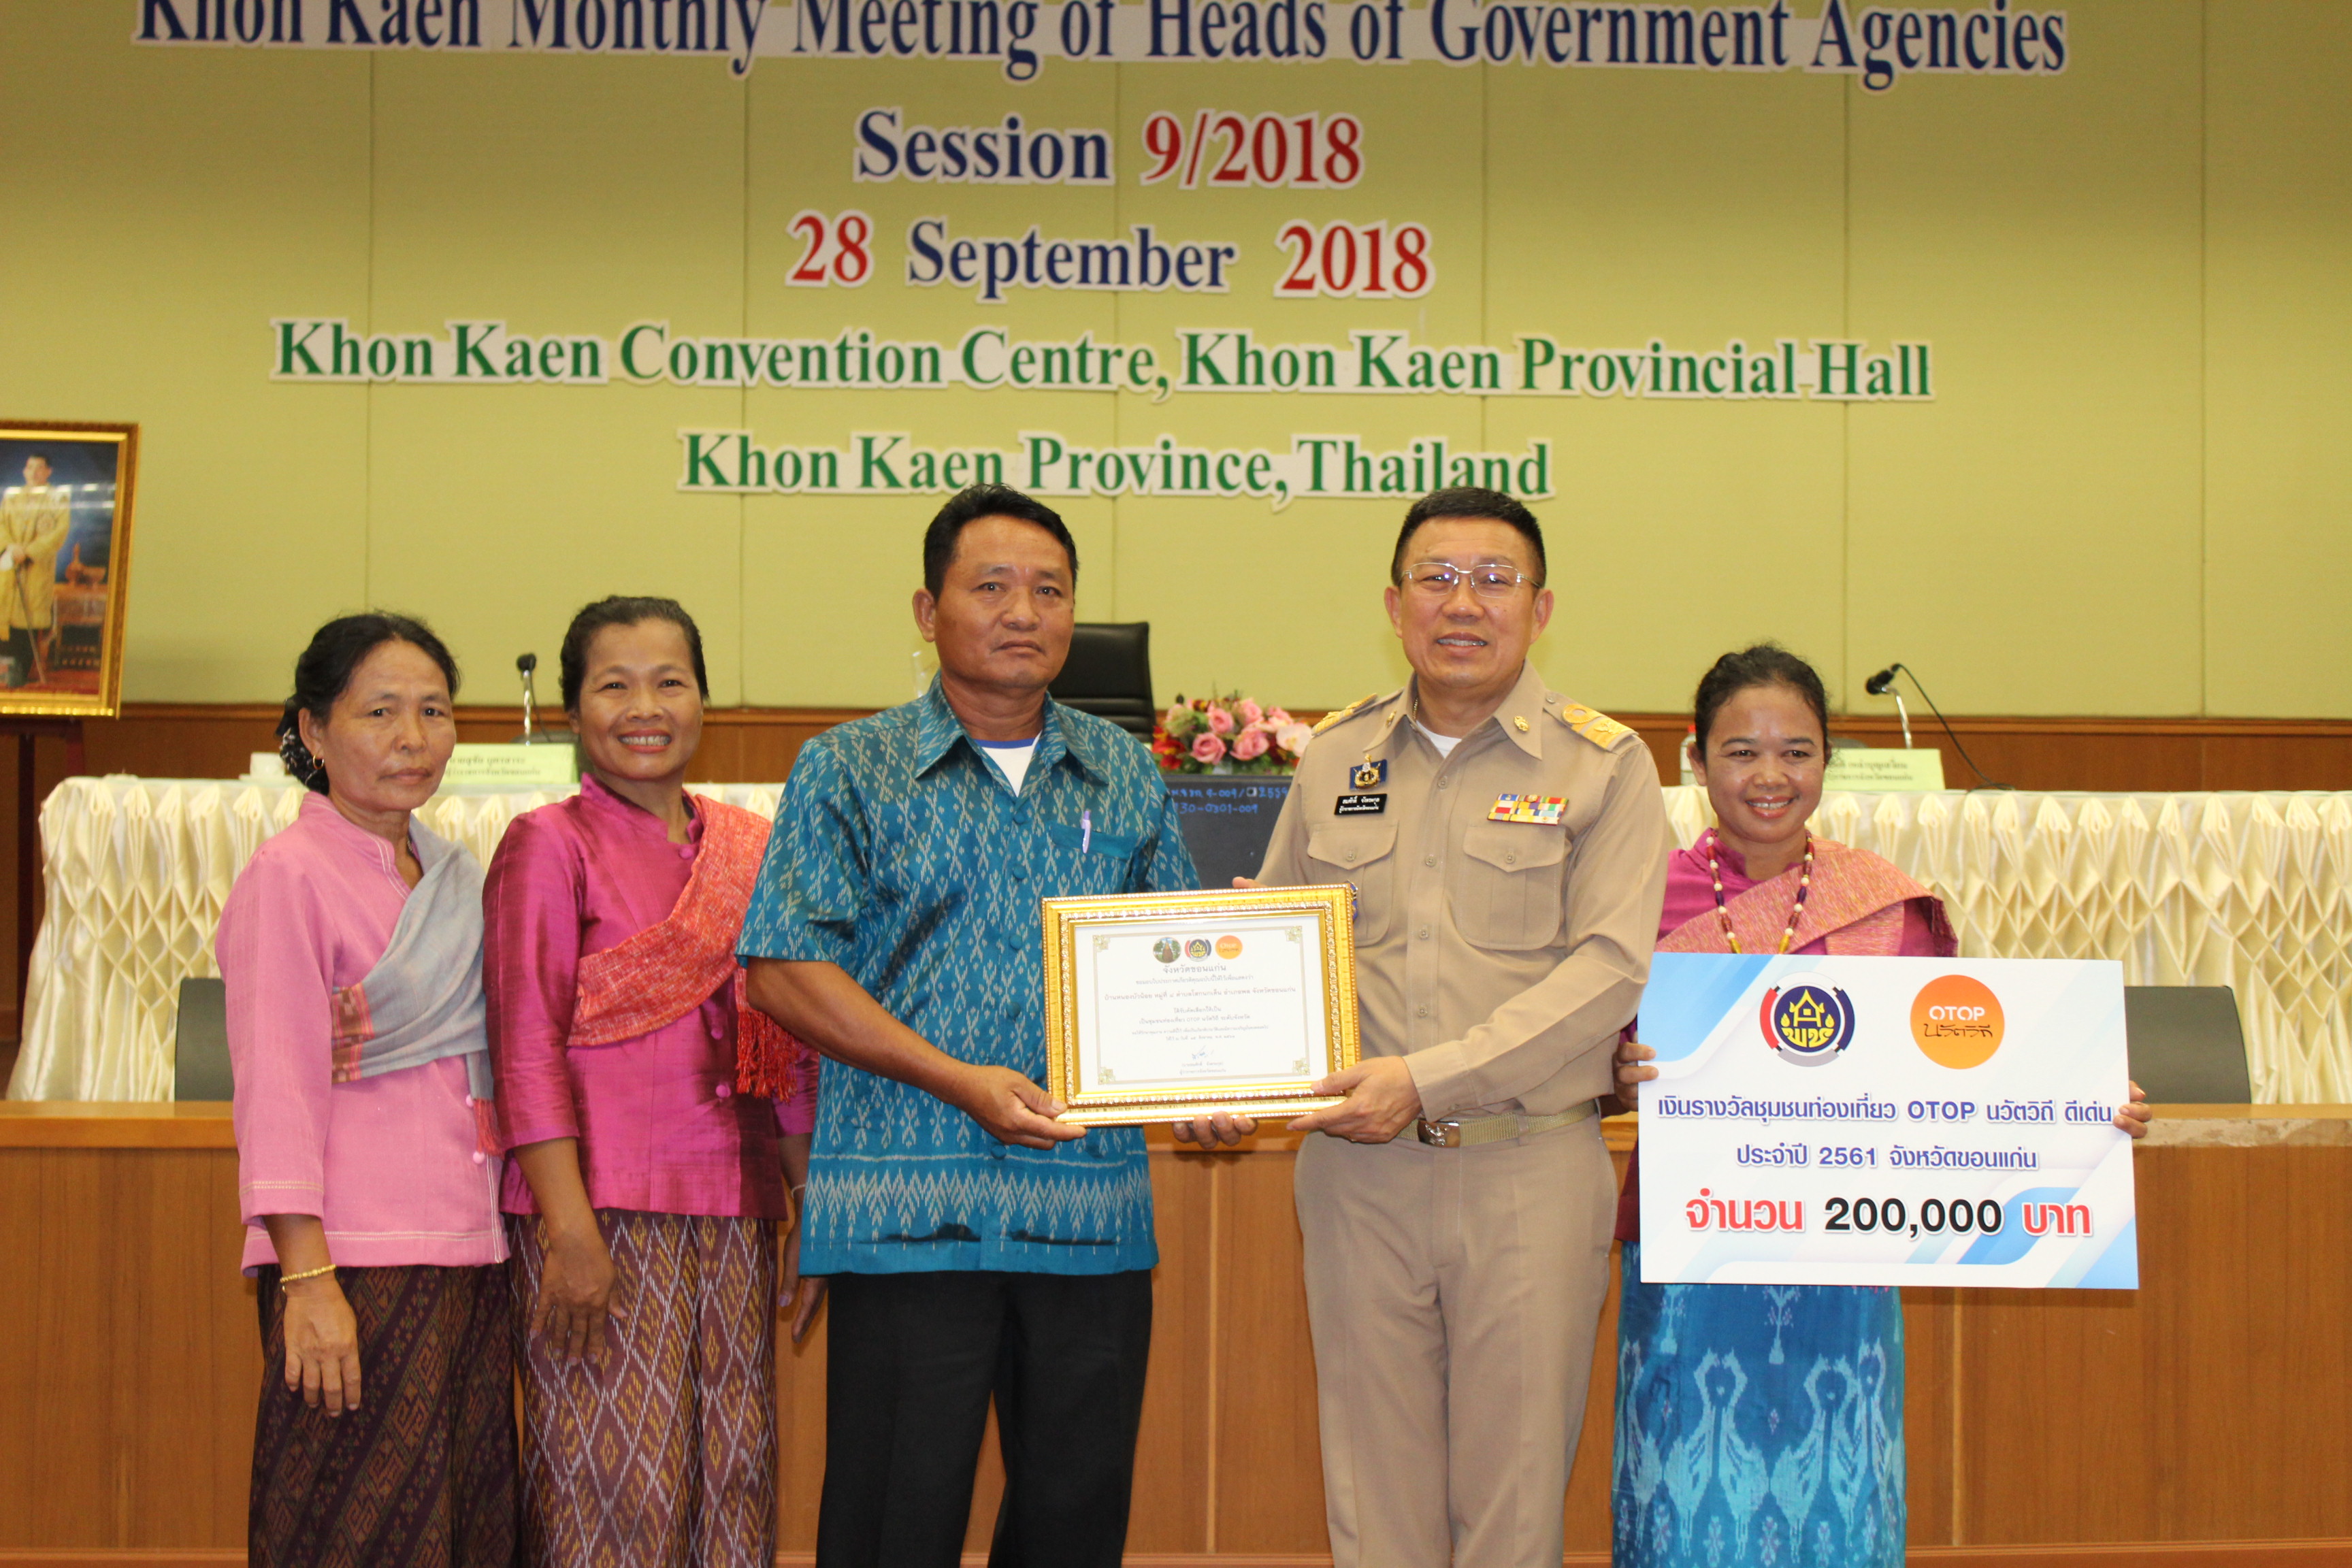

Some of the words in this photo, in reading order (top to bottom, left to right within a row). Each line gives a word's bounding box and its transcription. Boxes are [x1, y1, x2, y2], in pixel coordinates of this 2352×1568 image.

[793, 0, 1039, 80] Meeting
[1060, 0, 1115, 56] of
[1147, 0, 1327, 59] Heads
[1350, 0, 1404, 59] of
[1431, 0, 1790, 67] Government
[1812, 0, 2065, 91] Agencies
[857, 111, 1111, 180] Session
[1144, 114, 1361, 185] 9/2018
[791, 214, 870, 283] 28
[909, 220, 1235, 299] September
[1280, 225, 1428, 293] 2018
[276, 321, 434, 376] Khon
[453, 323, 601, 378] Kaen
[620, 325, 942, 385] Convention
[962, 330, 1169, 399] Centre,
[1181, 333, 1337, 387] Khon
[1354, 335, 1501, 390] Kaen
[1520, 338, 1797, 395] Provincial
[1816, 342, 1931, 396] Hall
[683, 434, 838, 489] Khon
[858, 436, 1004, 490] Kaen
[1296, 440, 1550, 495] Thailand
[1162, 962, 1227, 974] จังหวัดขอนแก่น
[1929, 1005, 1985, 1022] OTOP
[1657, 1092, 1896, 1123] เงินรางวัลชุมชนท่องเที่ยว
[1907, 1100, 1976, 1120] OTOP
[1986, 1099, 2055, 1122] นวัตวิถี
[2064, 1100, 2112, 1122] ดีเด่น
[1736, 1142, 1808, 1165] ประจำปี
[1818, 1146, 1876, 1166] 2561
[1889, 1145, 2038, 1168] จังหวัดขอนแก่น
[1685, 1188, 1803, 1231] จำนวน
[1825, 1196, 2003, 1239] 200,000
[2023, 1203, 2091, 1235] บาท
